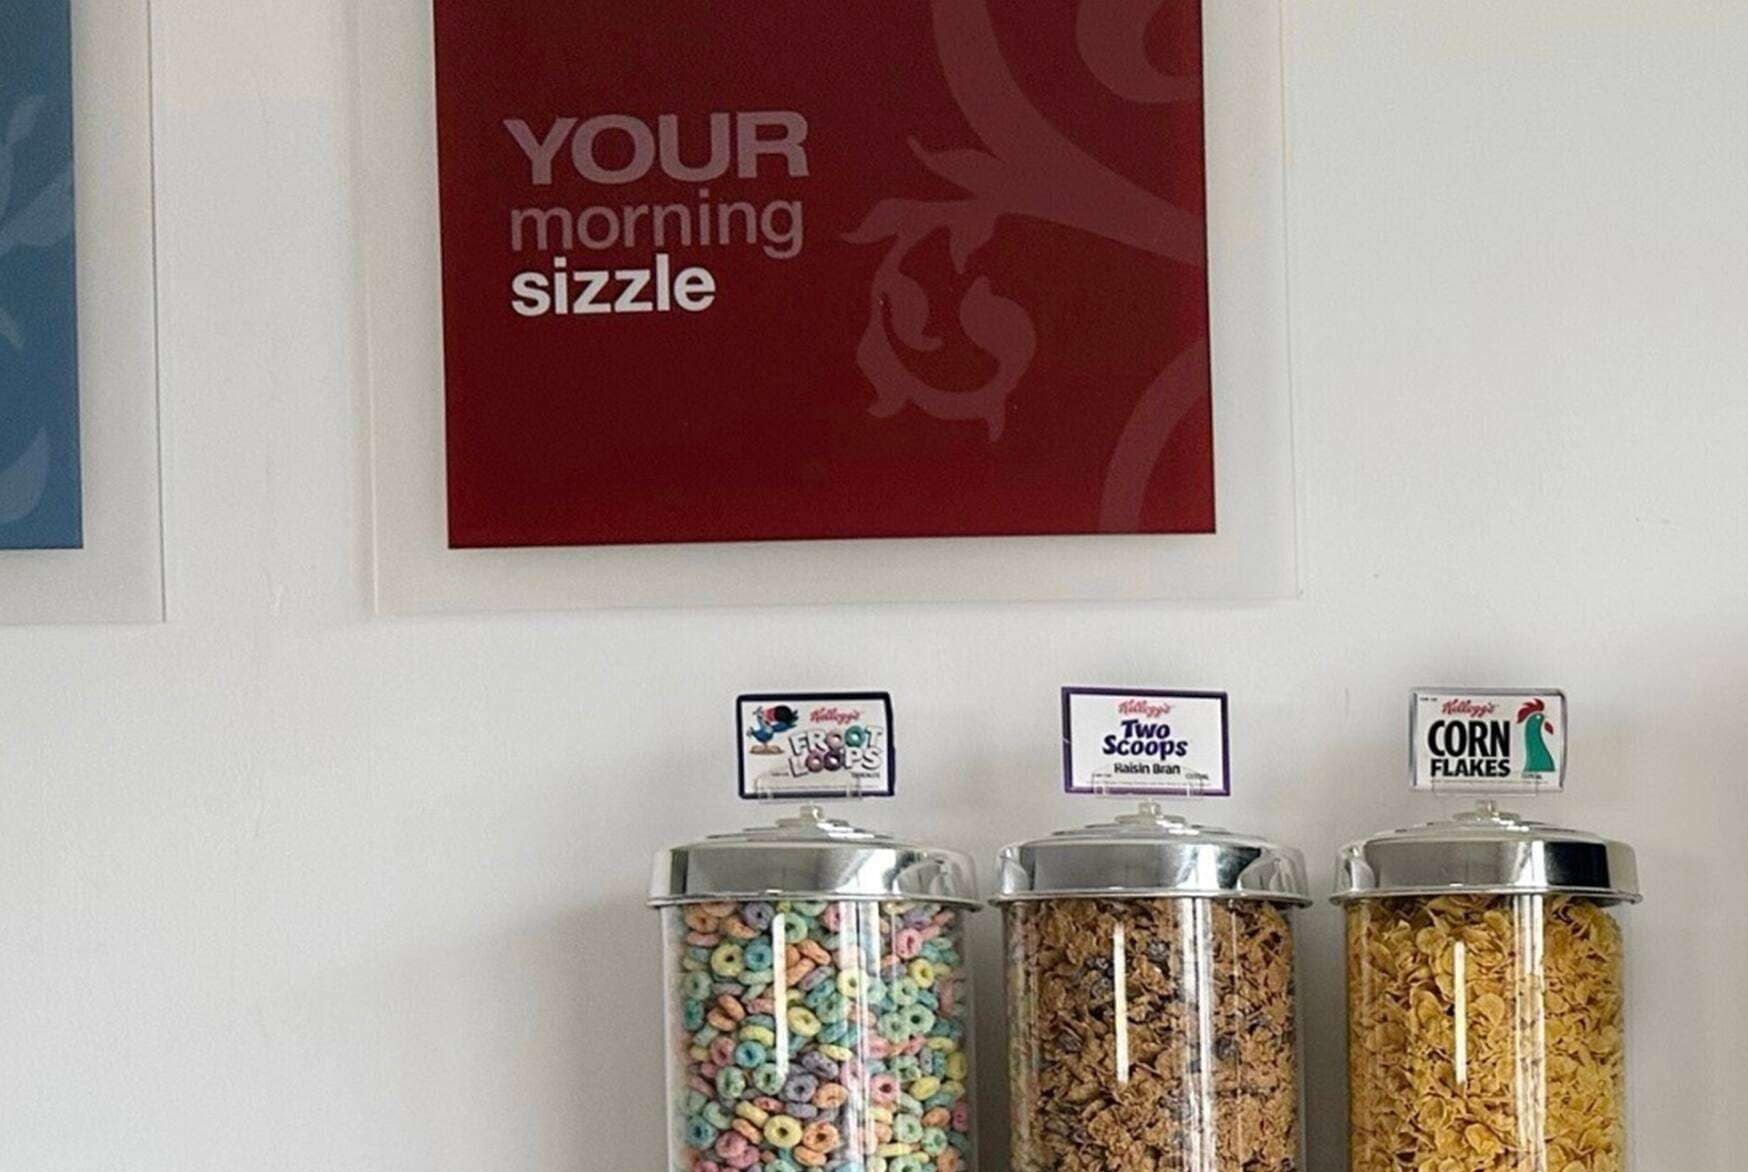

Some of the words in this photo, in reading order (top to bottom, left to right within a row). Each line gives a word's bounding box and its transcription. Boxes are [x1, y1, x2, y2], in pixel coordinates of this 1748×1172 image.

[503, 111, 810, 186] YOUR
[511, 188, 803, 260] morning
[511, 253, 716, 316] sizzle
[1440, 698, 1495, 717] Kellogg's
[1120, 719, 1171, 739] Two
[1428, 720, 1510, 757] CORN
[1102, 735, 1188, 761] Scoops
[1114, 763, 1150, 774] Raisin
[1153, 763, 1180, 774] Bran
[1430, 759, 1510, 777] FLAKES
